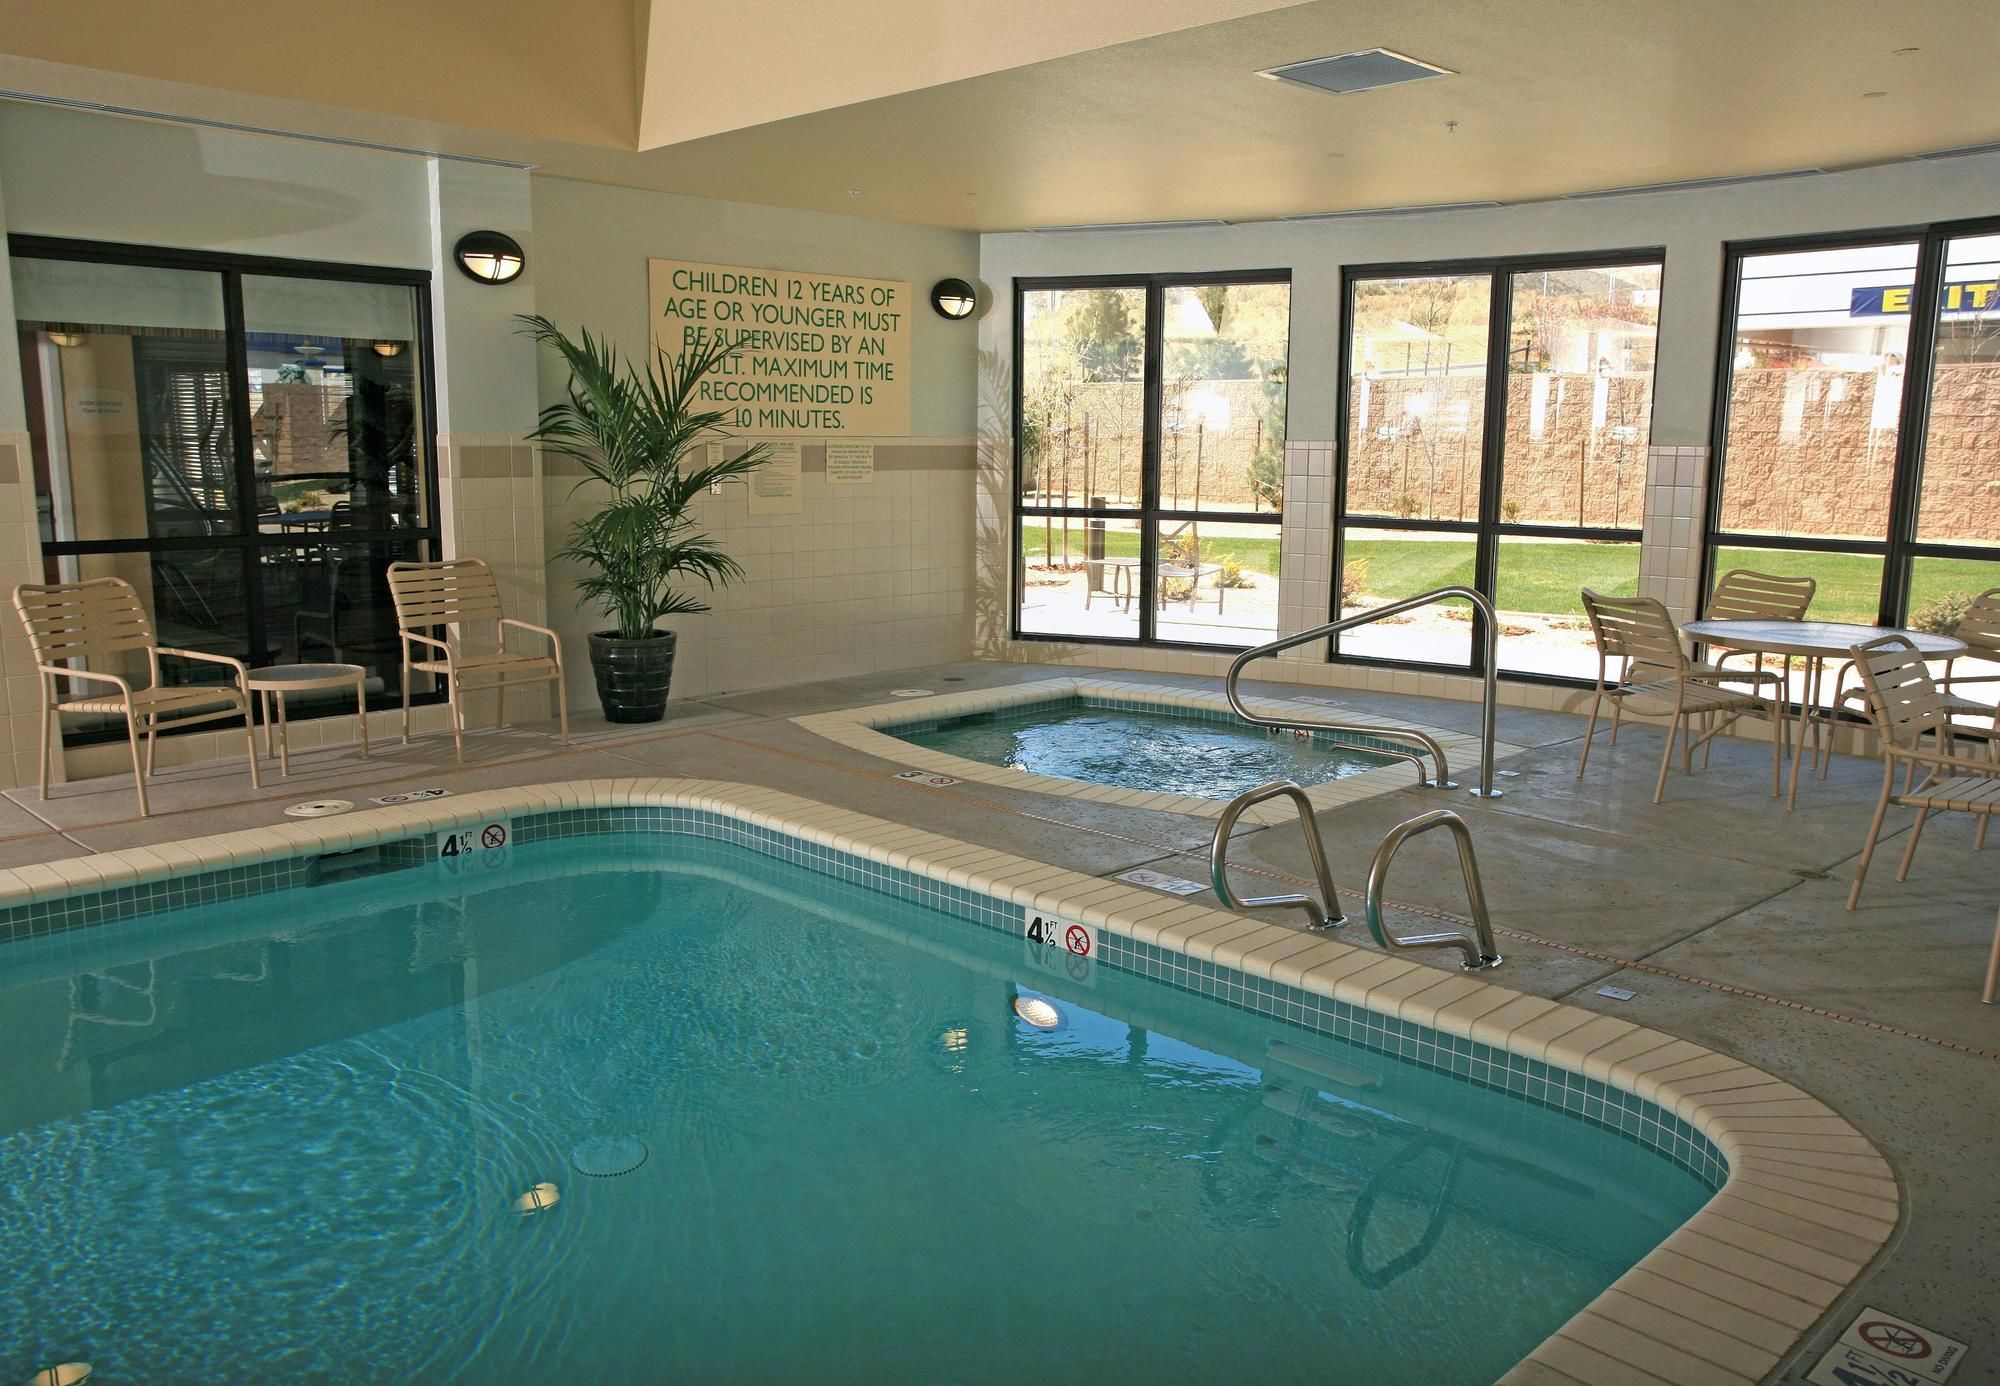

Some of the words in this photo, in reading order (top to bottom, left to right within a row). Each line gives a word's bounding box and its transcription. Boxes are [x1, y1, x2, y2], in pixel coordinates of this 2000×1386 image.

[672, 269, 778, 299] CHILDREN
[787, 279, 803, 300] 12
[809, 281, 865, 305] YEARS
[870, 287, 895, 307] OF
[1883, 284, 1997, 312] EIT
[664, 297, 707, 319] AGE
[713, 300, 745, 322] OR
[751, 303, 847, 329] YOUNGER
[853, 311, 901, 332] MUST
[684, 326, 707, 347] BE
[714, 327, 825, 352] SUPERVISED
[831, 335, 853, 353] BY
[858, 337, 885, 356] AN
[674, 353, 746, 375] AULT.
[752, 356, 848, 379] MAXIMUM
[854, 361, 894, 381] TIME
[700, 381, 854, 404] RECOMMENDED
[860, 386, 873, 405] IS
[735, 408, 752, 428] 10
[759, 409, 845, 429] MINUTES.
